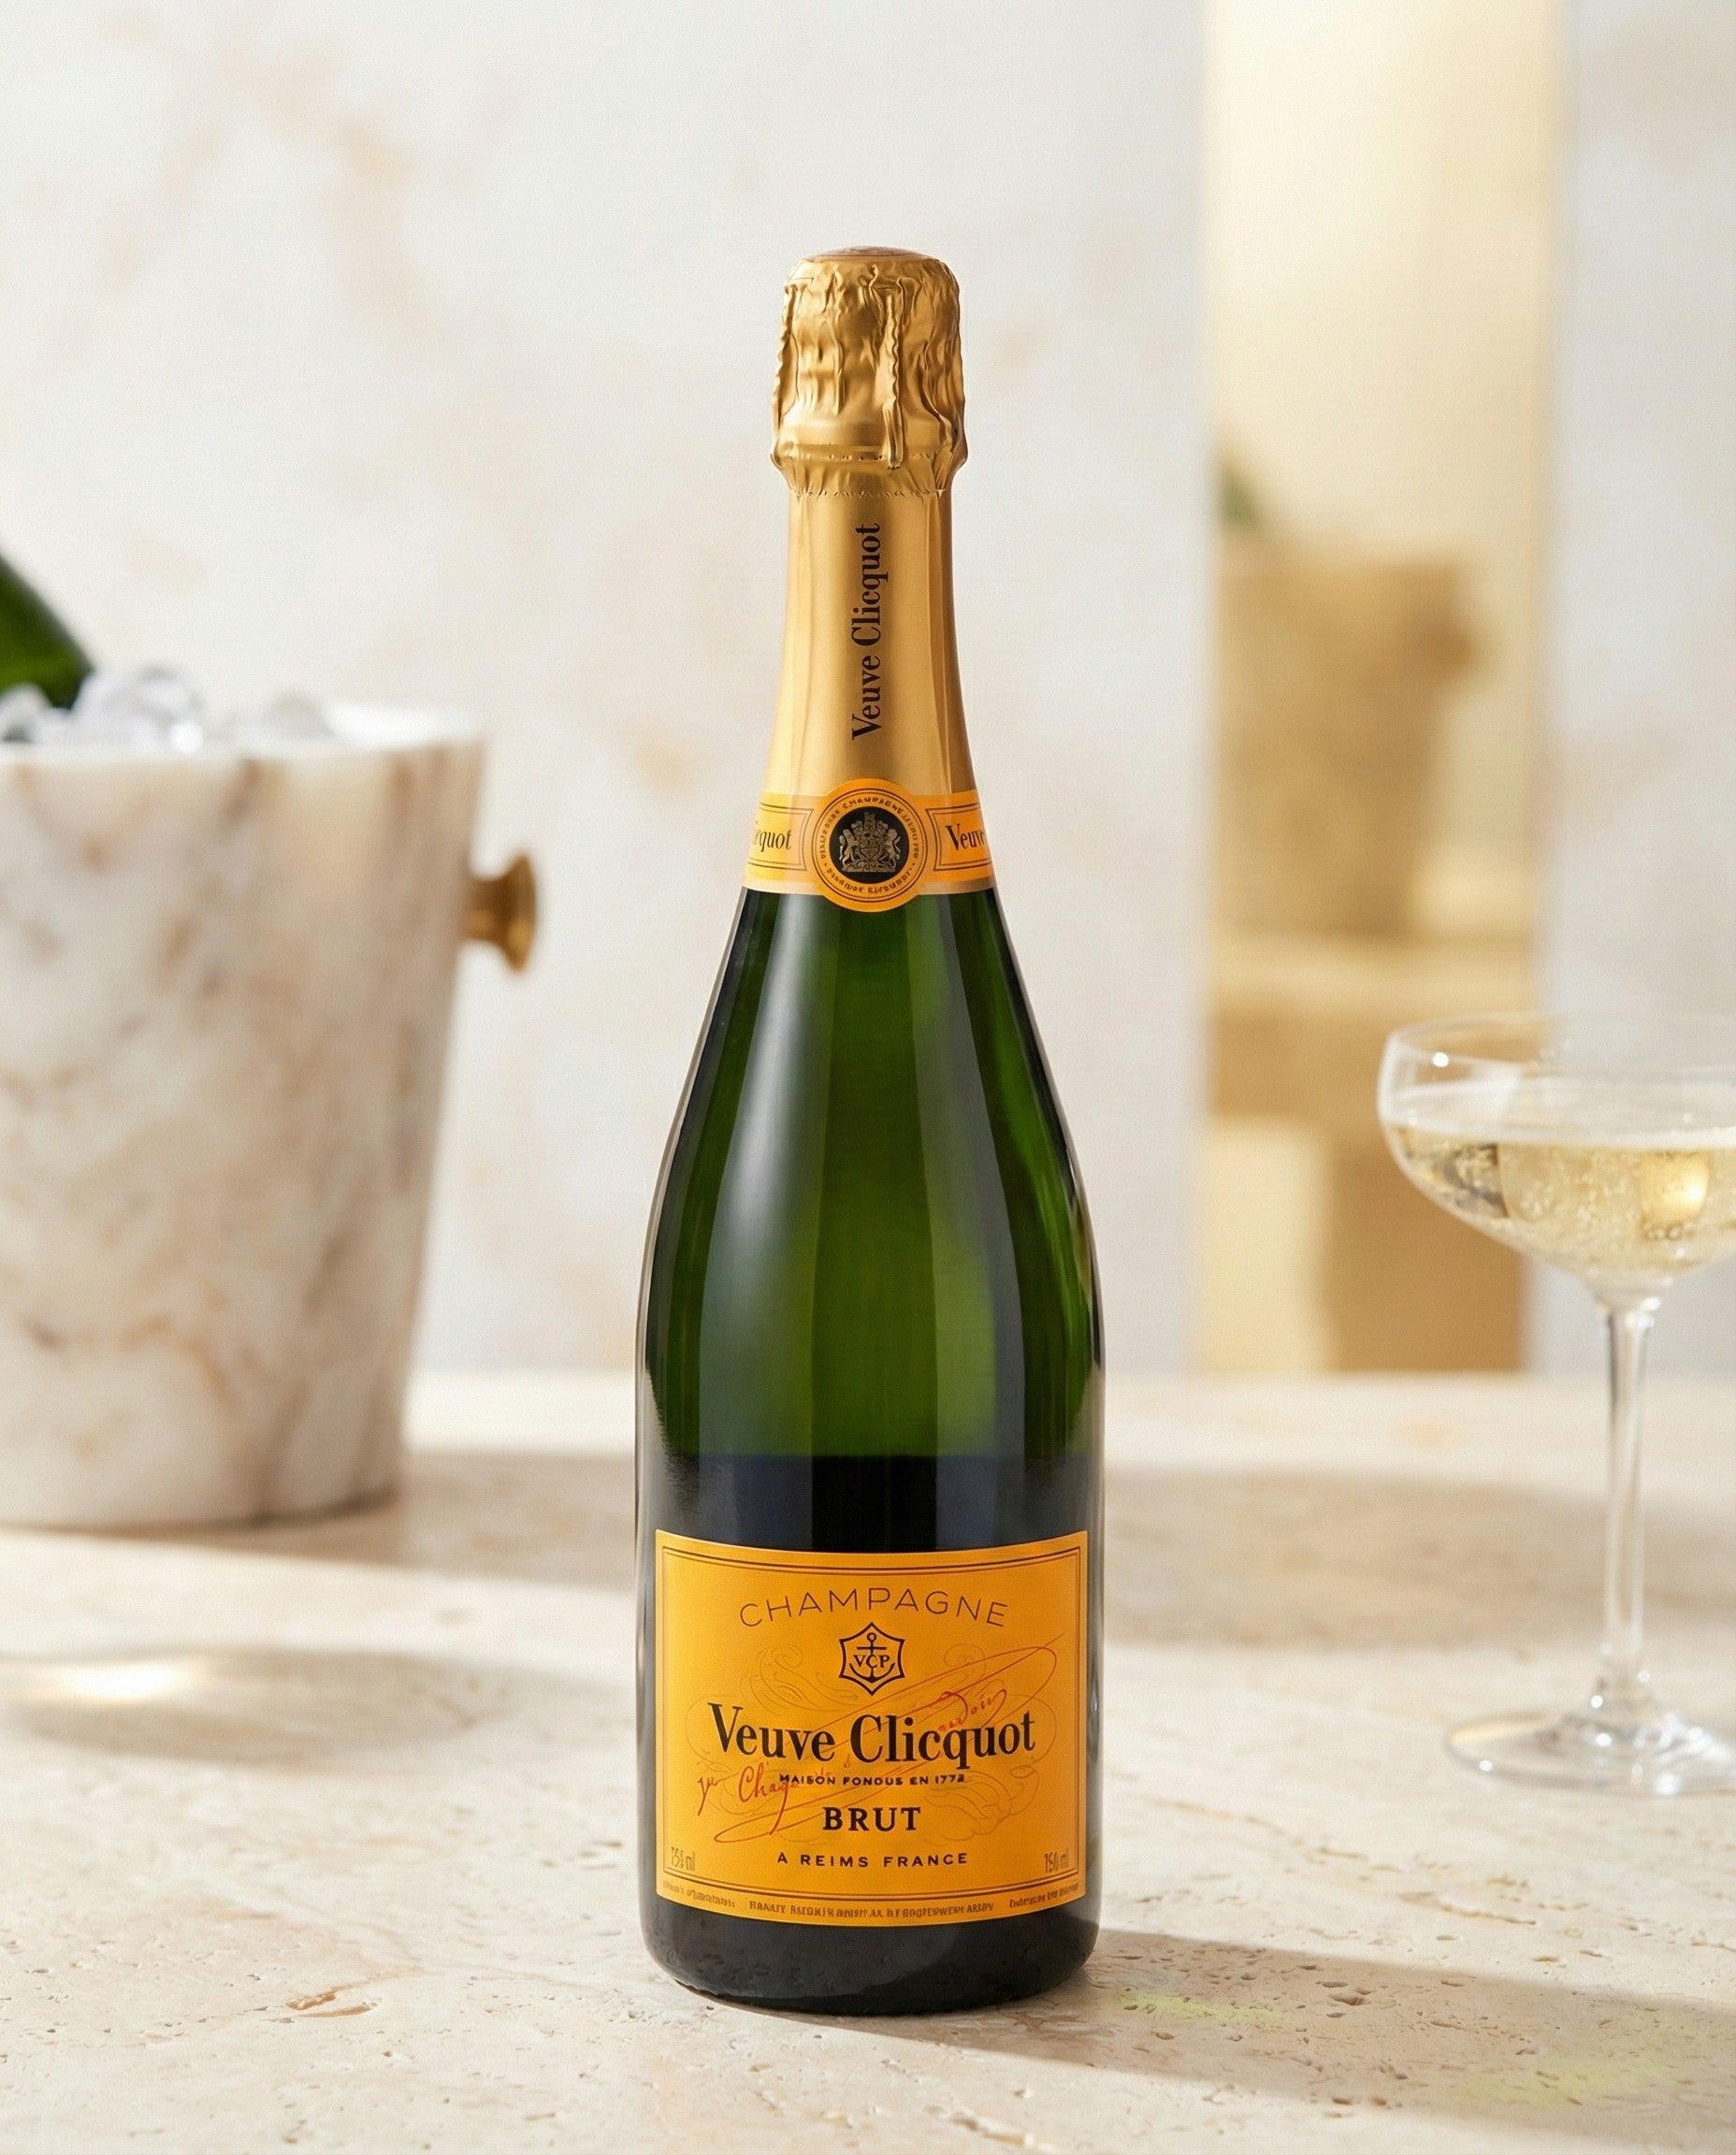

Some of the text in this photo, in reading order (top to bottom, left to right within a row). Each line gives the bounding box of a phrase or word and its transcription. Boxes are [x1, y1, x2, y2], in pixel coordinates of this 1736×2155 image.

[851, 523, 888, 740] Veuve Clicquot
[739, 1586, 1009, 1627] CHAMPAGNE
[853, 1654, 890, 1670] VCP
[707, 1701, 835, 1762] Veuve
[849, 1710, 1036, 1771] Clicquot
[779, 1773, 836, 1786] MAISON
[909, 1775, 929, 1786] EN
[822, 1806, 921, 1832] BRUT
[776, 1851, 968, 1868] A REIMS FRANCE
